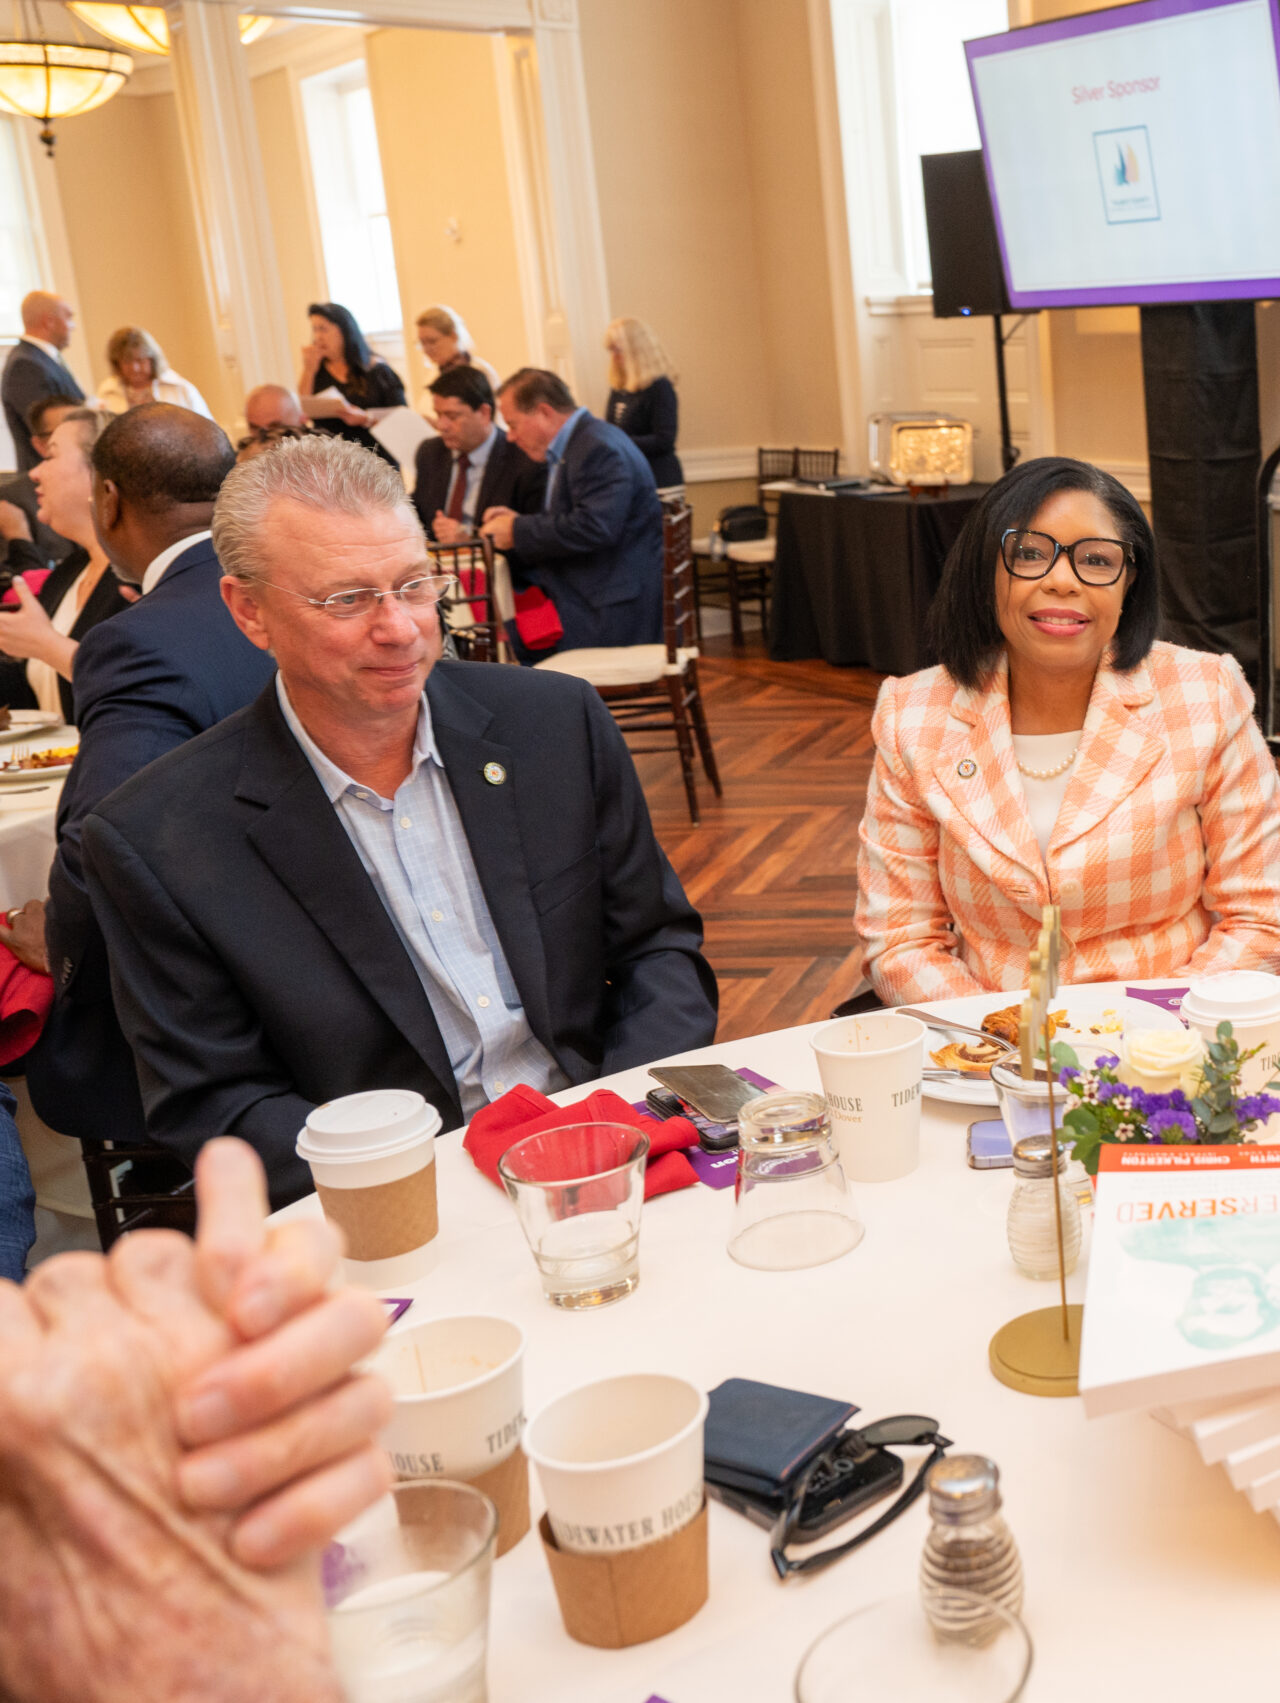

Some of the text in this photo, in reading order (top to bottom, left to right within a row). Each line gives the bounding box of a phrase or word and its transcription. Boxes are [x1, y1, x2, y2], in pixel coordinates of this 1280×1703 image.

[1071, 76, 1161, 105] Silver Sponsor
[1121, 1155, 1231, 1166] CHRIS PILKERTON
